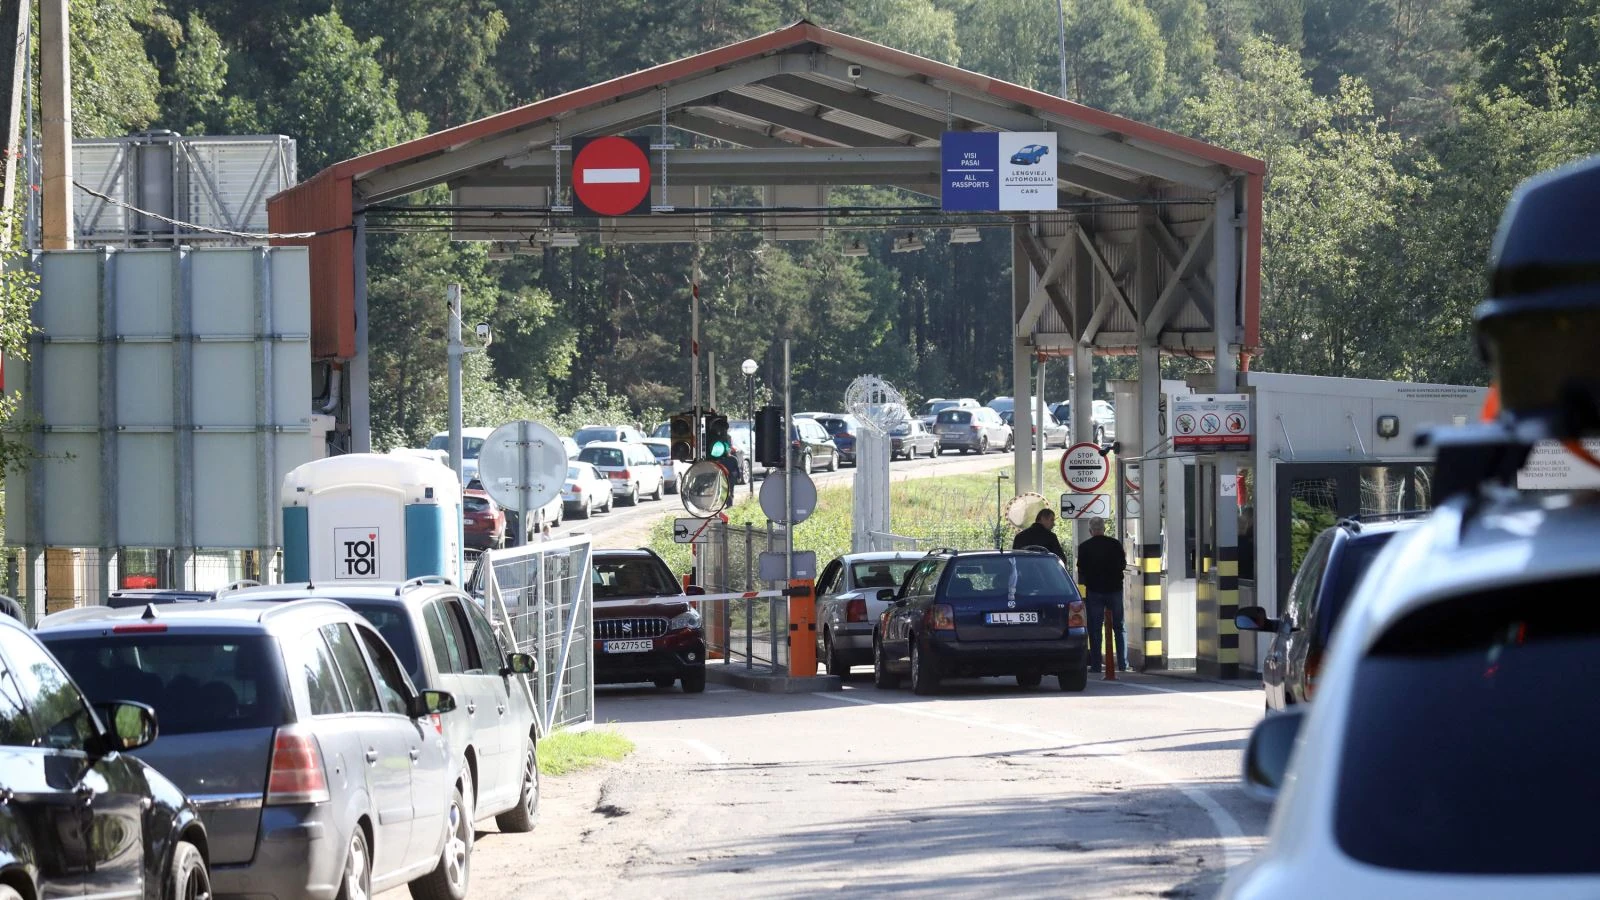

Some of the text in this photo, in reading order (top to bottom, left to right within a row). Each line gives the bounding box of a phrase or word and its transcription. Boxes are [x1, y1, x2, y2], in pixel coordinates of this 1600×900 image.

[344, 558, 375, 575] TOI
[991, 613, 1037, 622] LLL 636
[608, 640, 652, 650] KA 2775 CE
